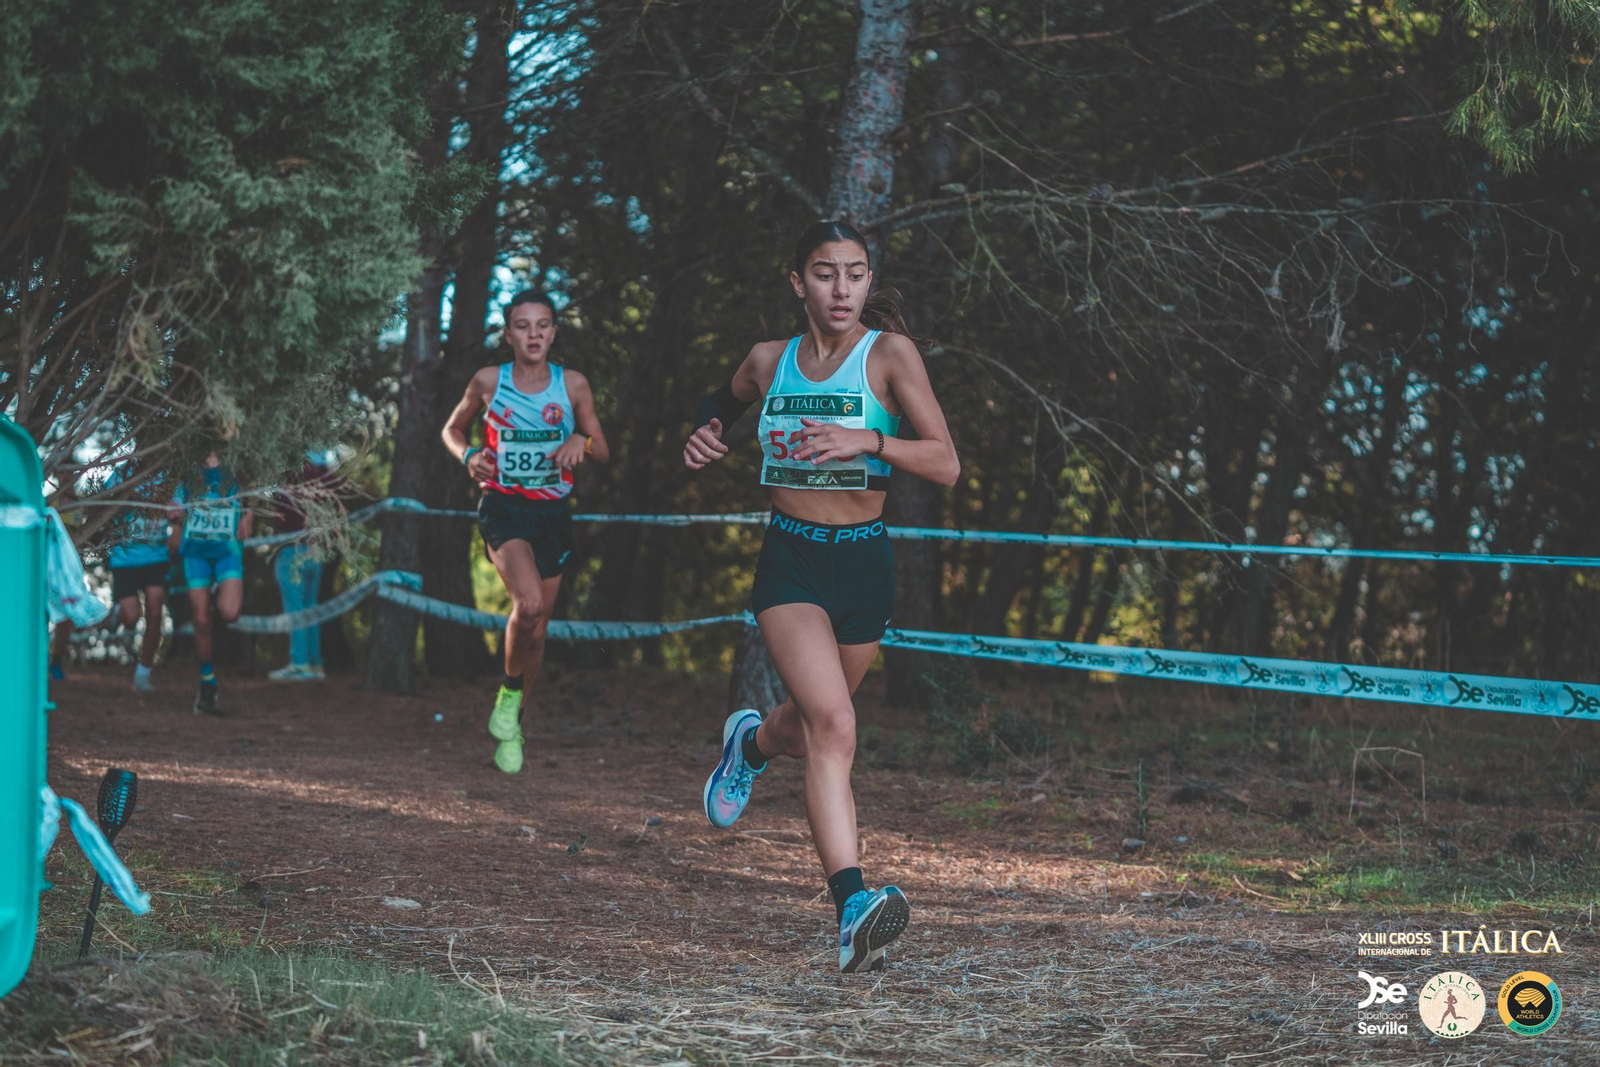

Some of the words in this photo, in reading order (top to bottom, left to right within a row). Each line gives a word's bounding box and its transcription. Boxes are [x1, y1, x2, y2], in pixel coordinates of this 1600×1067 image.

[790, 396, 836, 409] ITÁLICA
[504, 451, 560, 471] 582
[192, 514, 229, 529] 7961
[772, 514, 830, 543] NIKE
[834, 521, 884, 544] PRO
[1274, 674, 1306, 687] Sevilla
[1377, 683, 1411, 697] Sevilla
[1487, 693, 1522, 707] Sevilla
